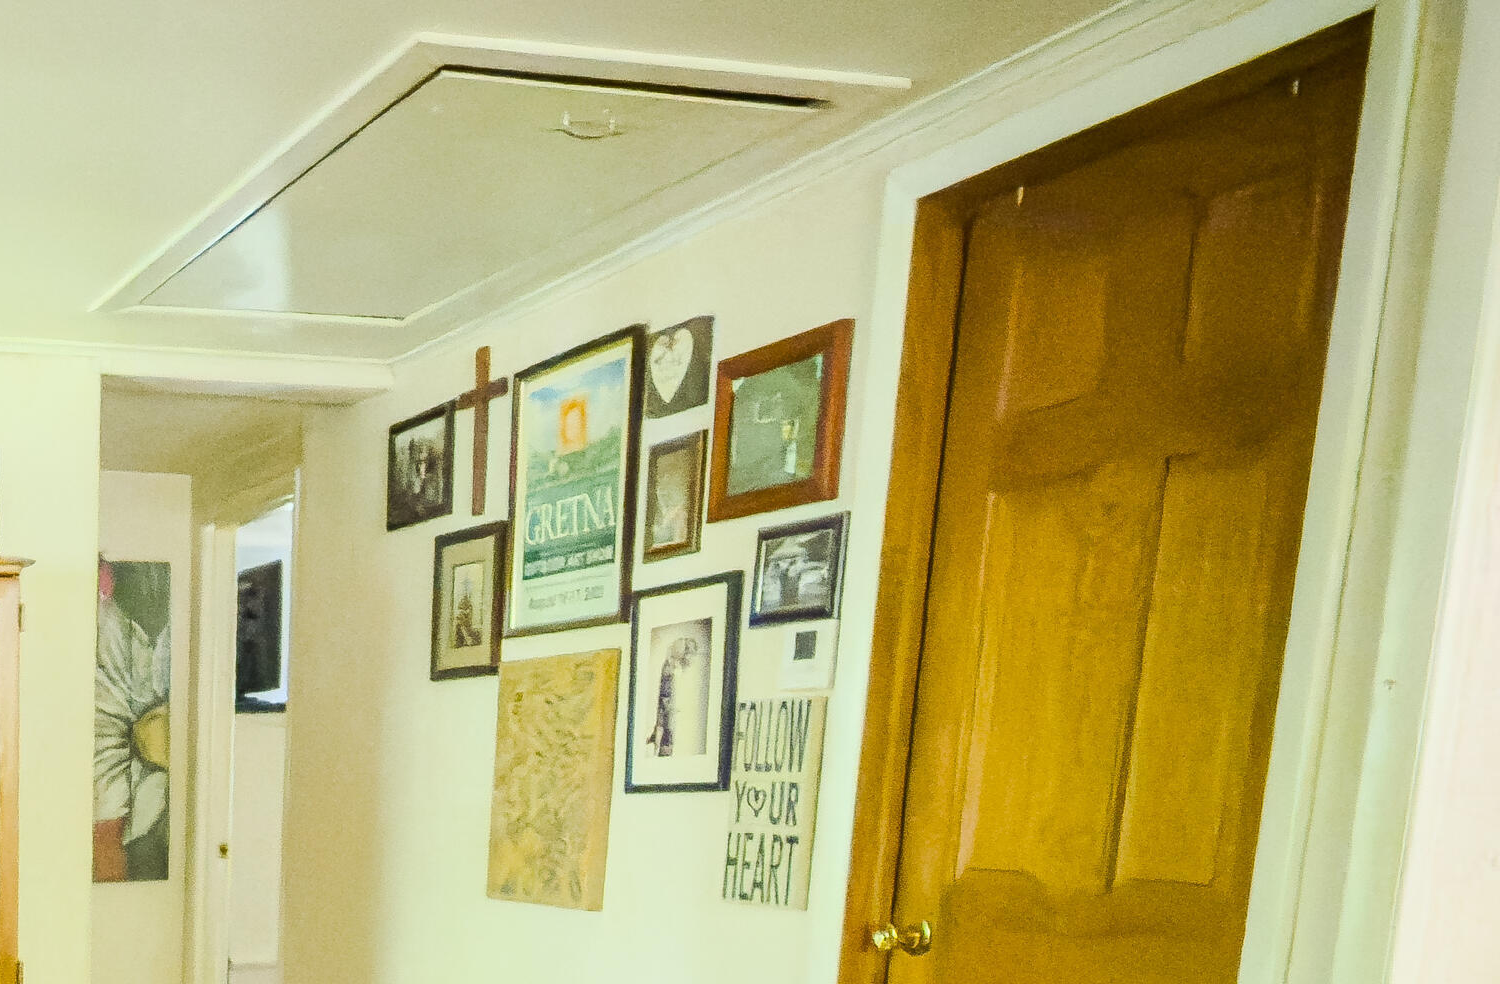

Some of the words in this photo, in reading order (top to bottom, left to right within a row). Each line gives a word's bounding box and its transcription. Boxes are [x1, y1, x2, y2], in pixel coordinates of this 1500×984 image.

[525, 484, 616, 545] GRETNA
[732, 699, 812, 772] FOLLOW
[722, 832, 800, 905] HEART
